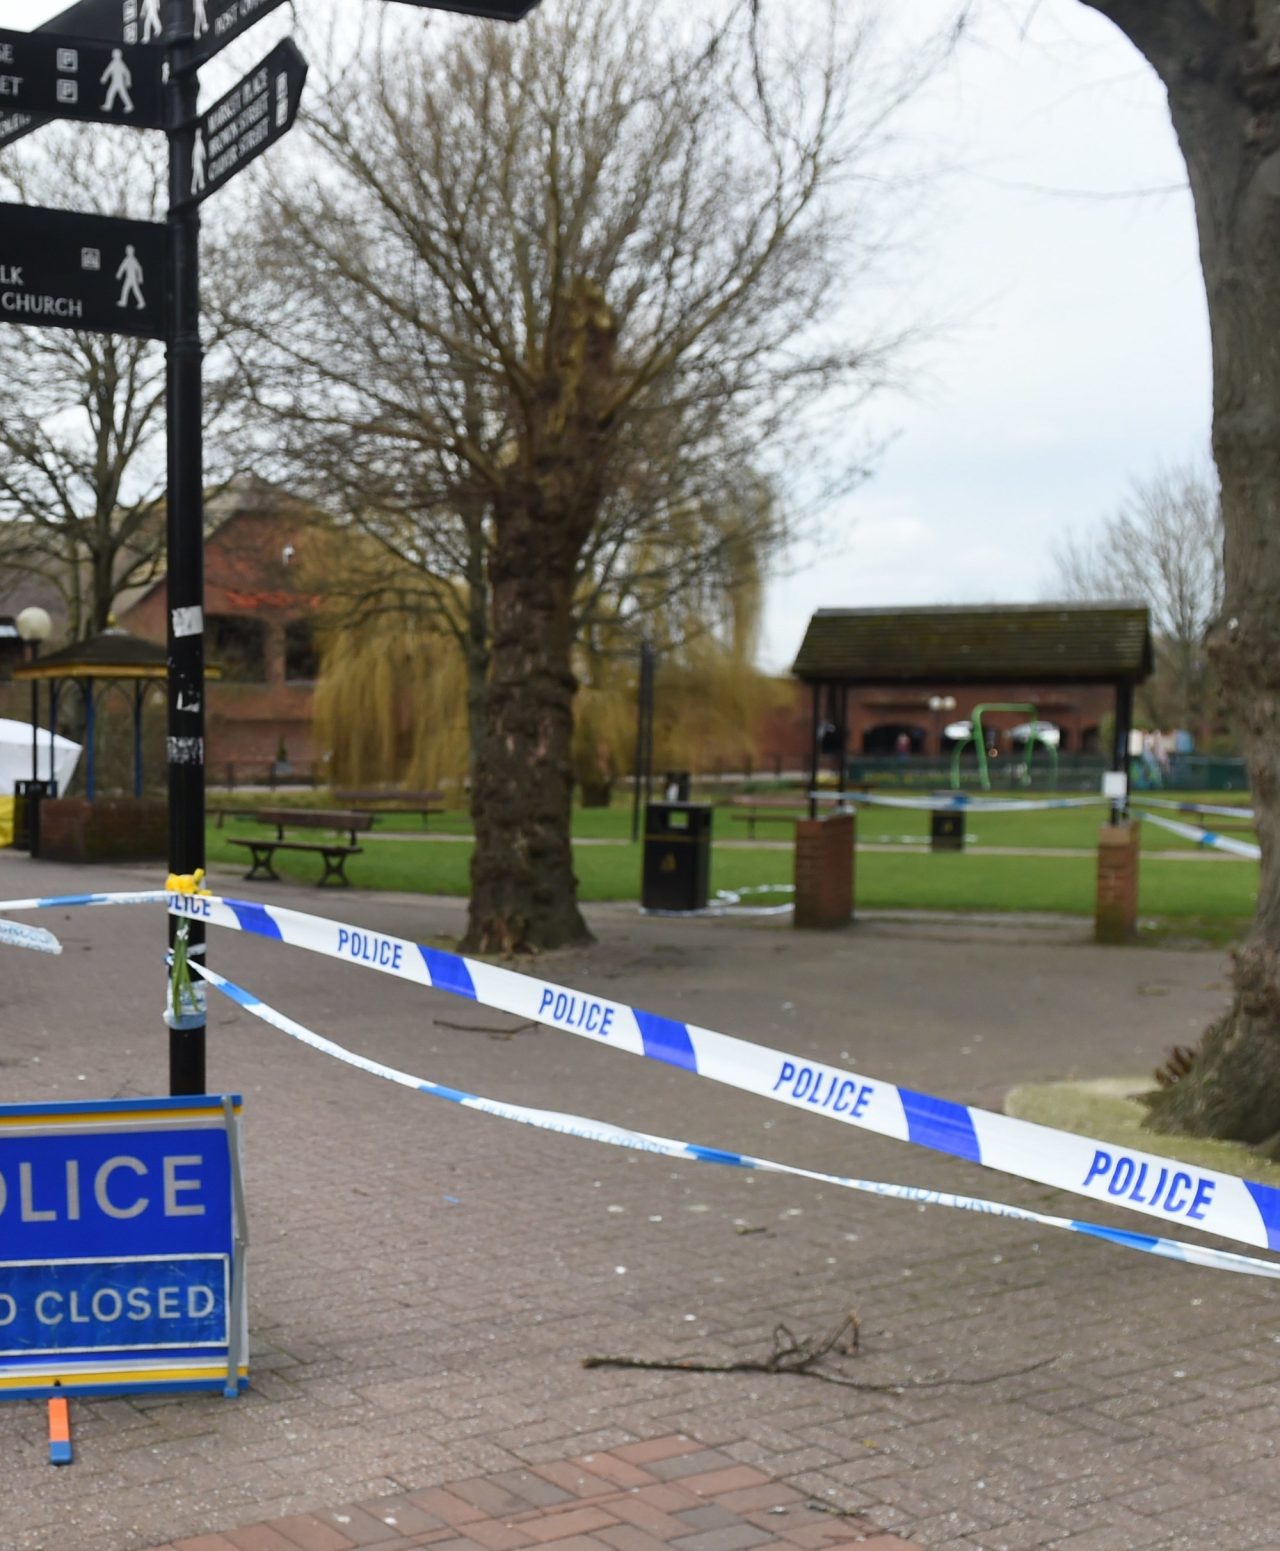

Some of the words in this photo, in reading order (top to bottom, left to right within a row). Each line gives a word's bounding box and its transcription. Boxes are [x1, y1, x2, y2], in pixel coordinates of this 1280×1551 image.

[1, 291, 83, 318] CHURCH
[338, 928, 403, 970] POLICE
[539, 988, 615, 1036] POLICE
[773, 1062, 874, 1118] POLICE
[1083, 1150, 1216, 1221] POLICE
[34, 1285, 216, 1325] CLOSED
